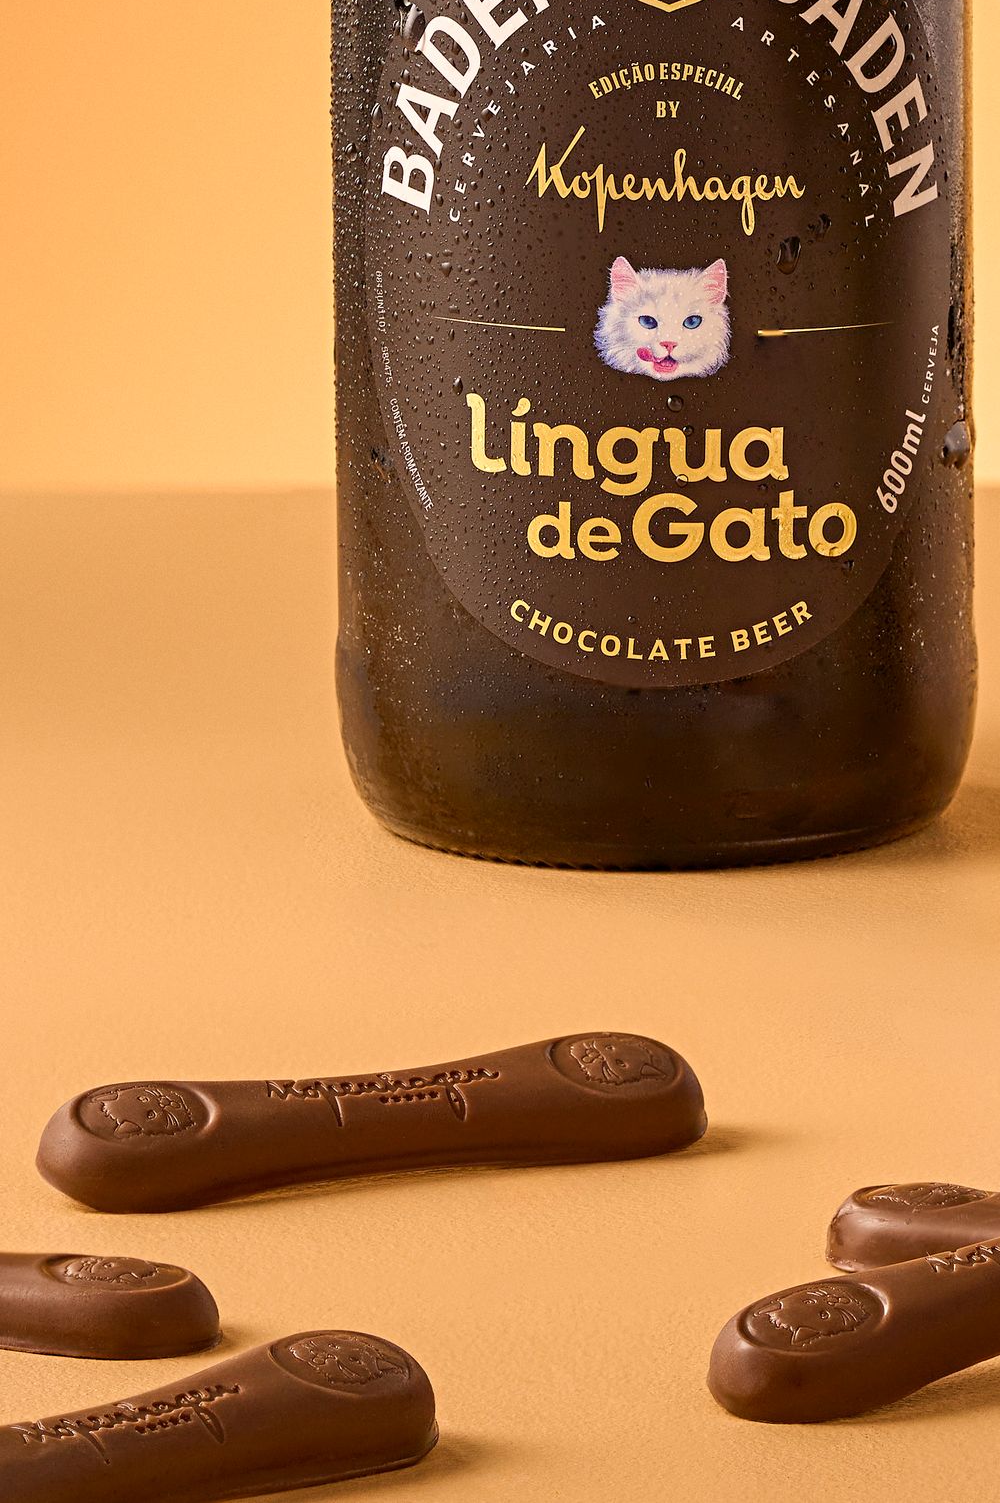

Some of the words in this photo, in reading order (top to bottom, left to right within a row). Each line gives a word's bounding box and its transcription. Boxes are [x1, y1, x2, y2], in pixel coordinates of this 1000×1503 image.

[449, 15, 607, 223] CERVEJARIA
[730, 15, 876, 228] ARTESANAL
[587, 61, 655, 100] EDIÇÃO
[659, 62, 745, 101] ESPECIAL
[656, 100, 681, 118] BY
[525, 125, 806, 237] Kopenhagen
[389, 398, 408, 444] CONTÉM
[400, 439, 434, 512] AROMATIZANTE
[876, 409, 927, 514] 600ml
[921, 324, 940, 404] CERVEJA
[527, 501, 622, 561] de
[632, 490, 858, 563] Gato
[509, 598, 717, 662] CHOCOLATE
[732, 599, 814, 654] BEER
